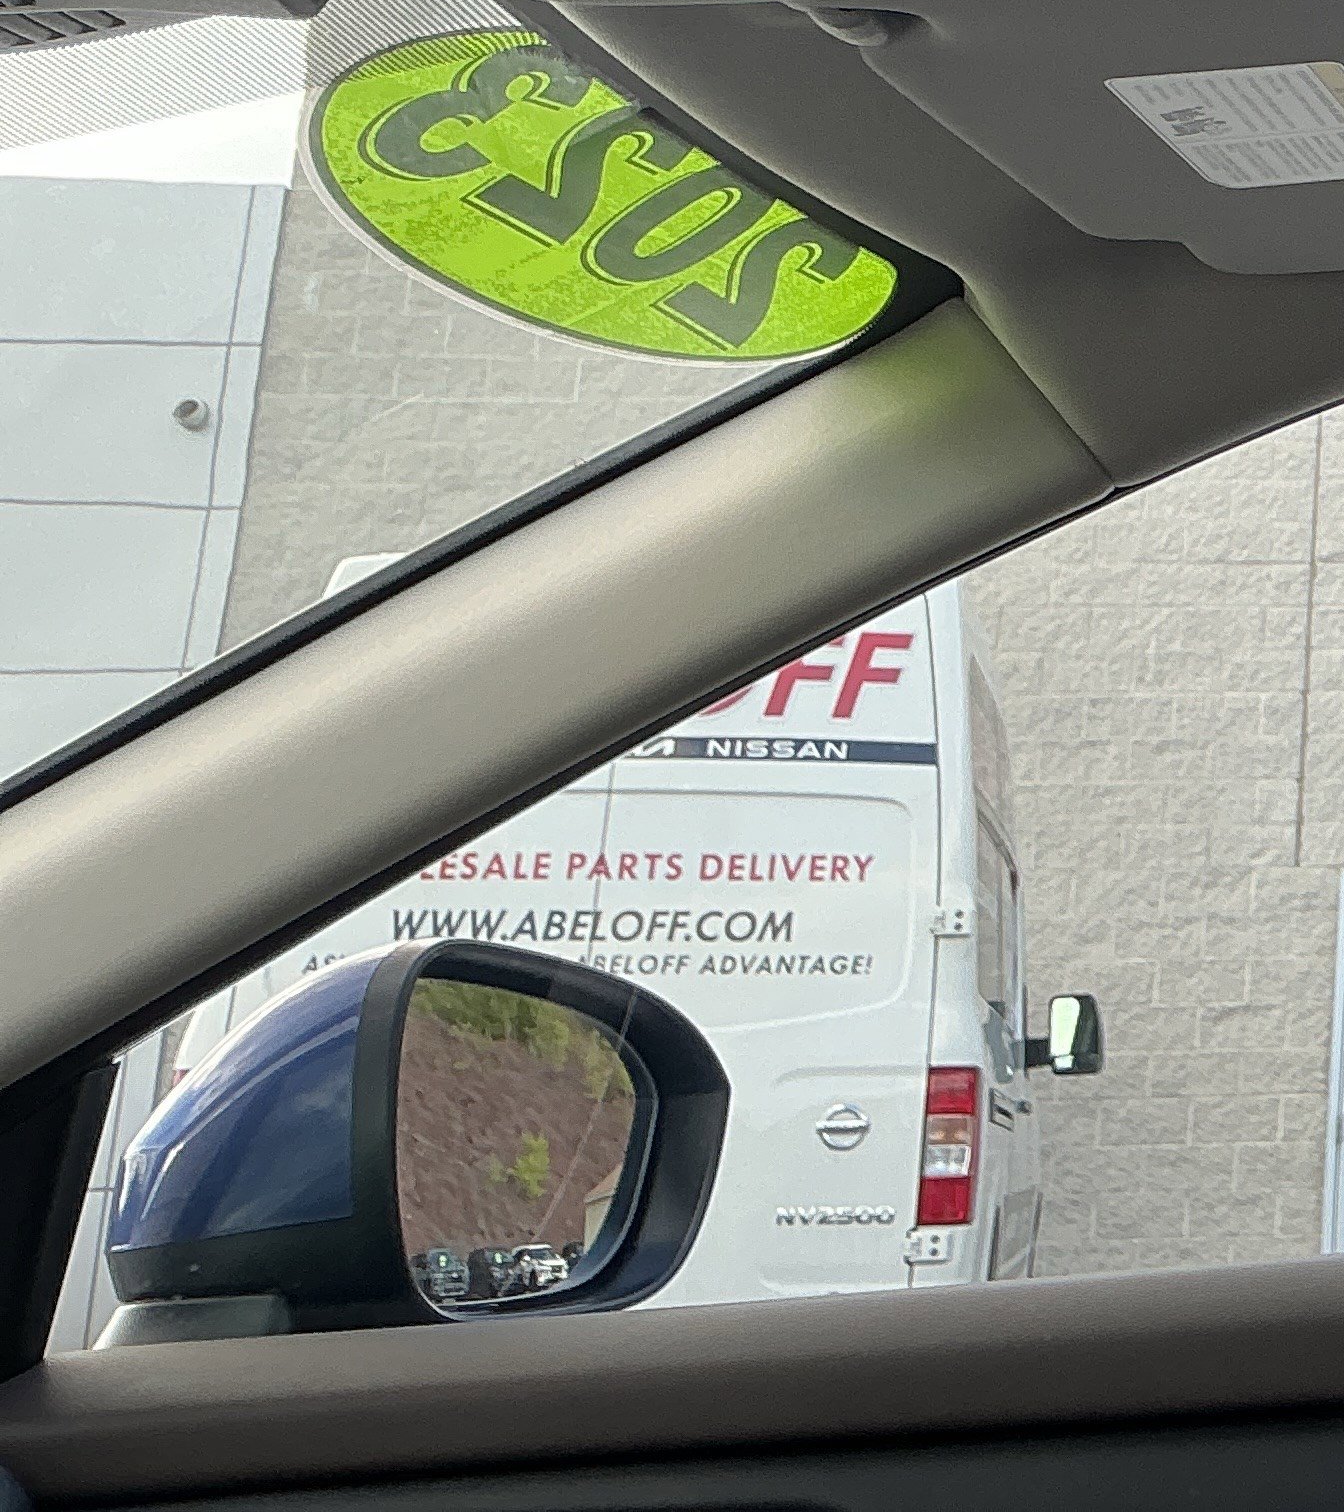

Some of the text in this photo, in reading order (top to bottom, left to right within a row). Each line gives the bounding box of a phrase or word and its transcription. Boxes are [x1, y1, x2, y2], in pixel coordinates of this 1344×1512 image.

[700, 632, 914, 719] FF
[706, 738, 848, 760] NISSAN
[566, 852, 683, 881] PARTS
[698, 853, 874, 883] DELIVERY
[392, 908, 795, 943] WWW.ABELOFF.COM
[698, 954, 874, 976] ADVANTAGE!
[775, 1206, 897, 1226] NV2500
